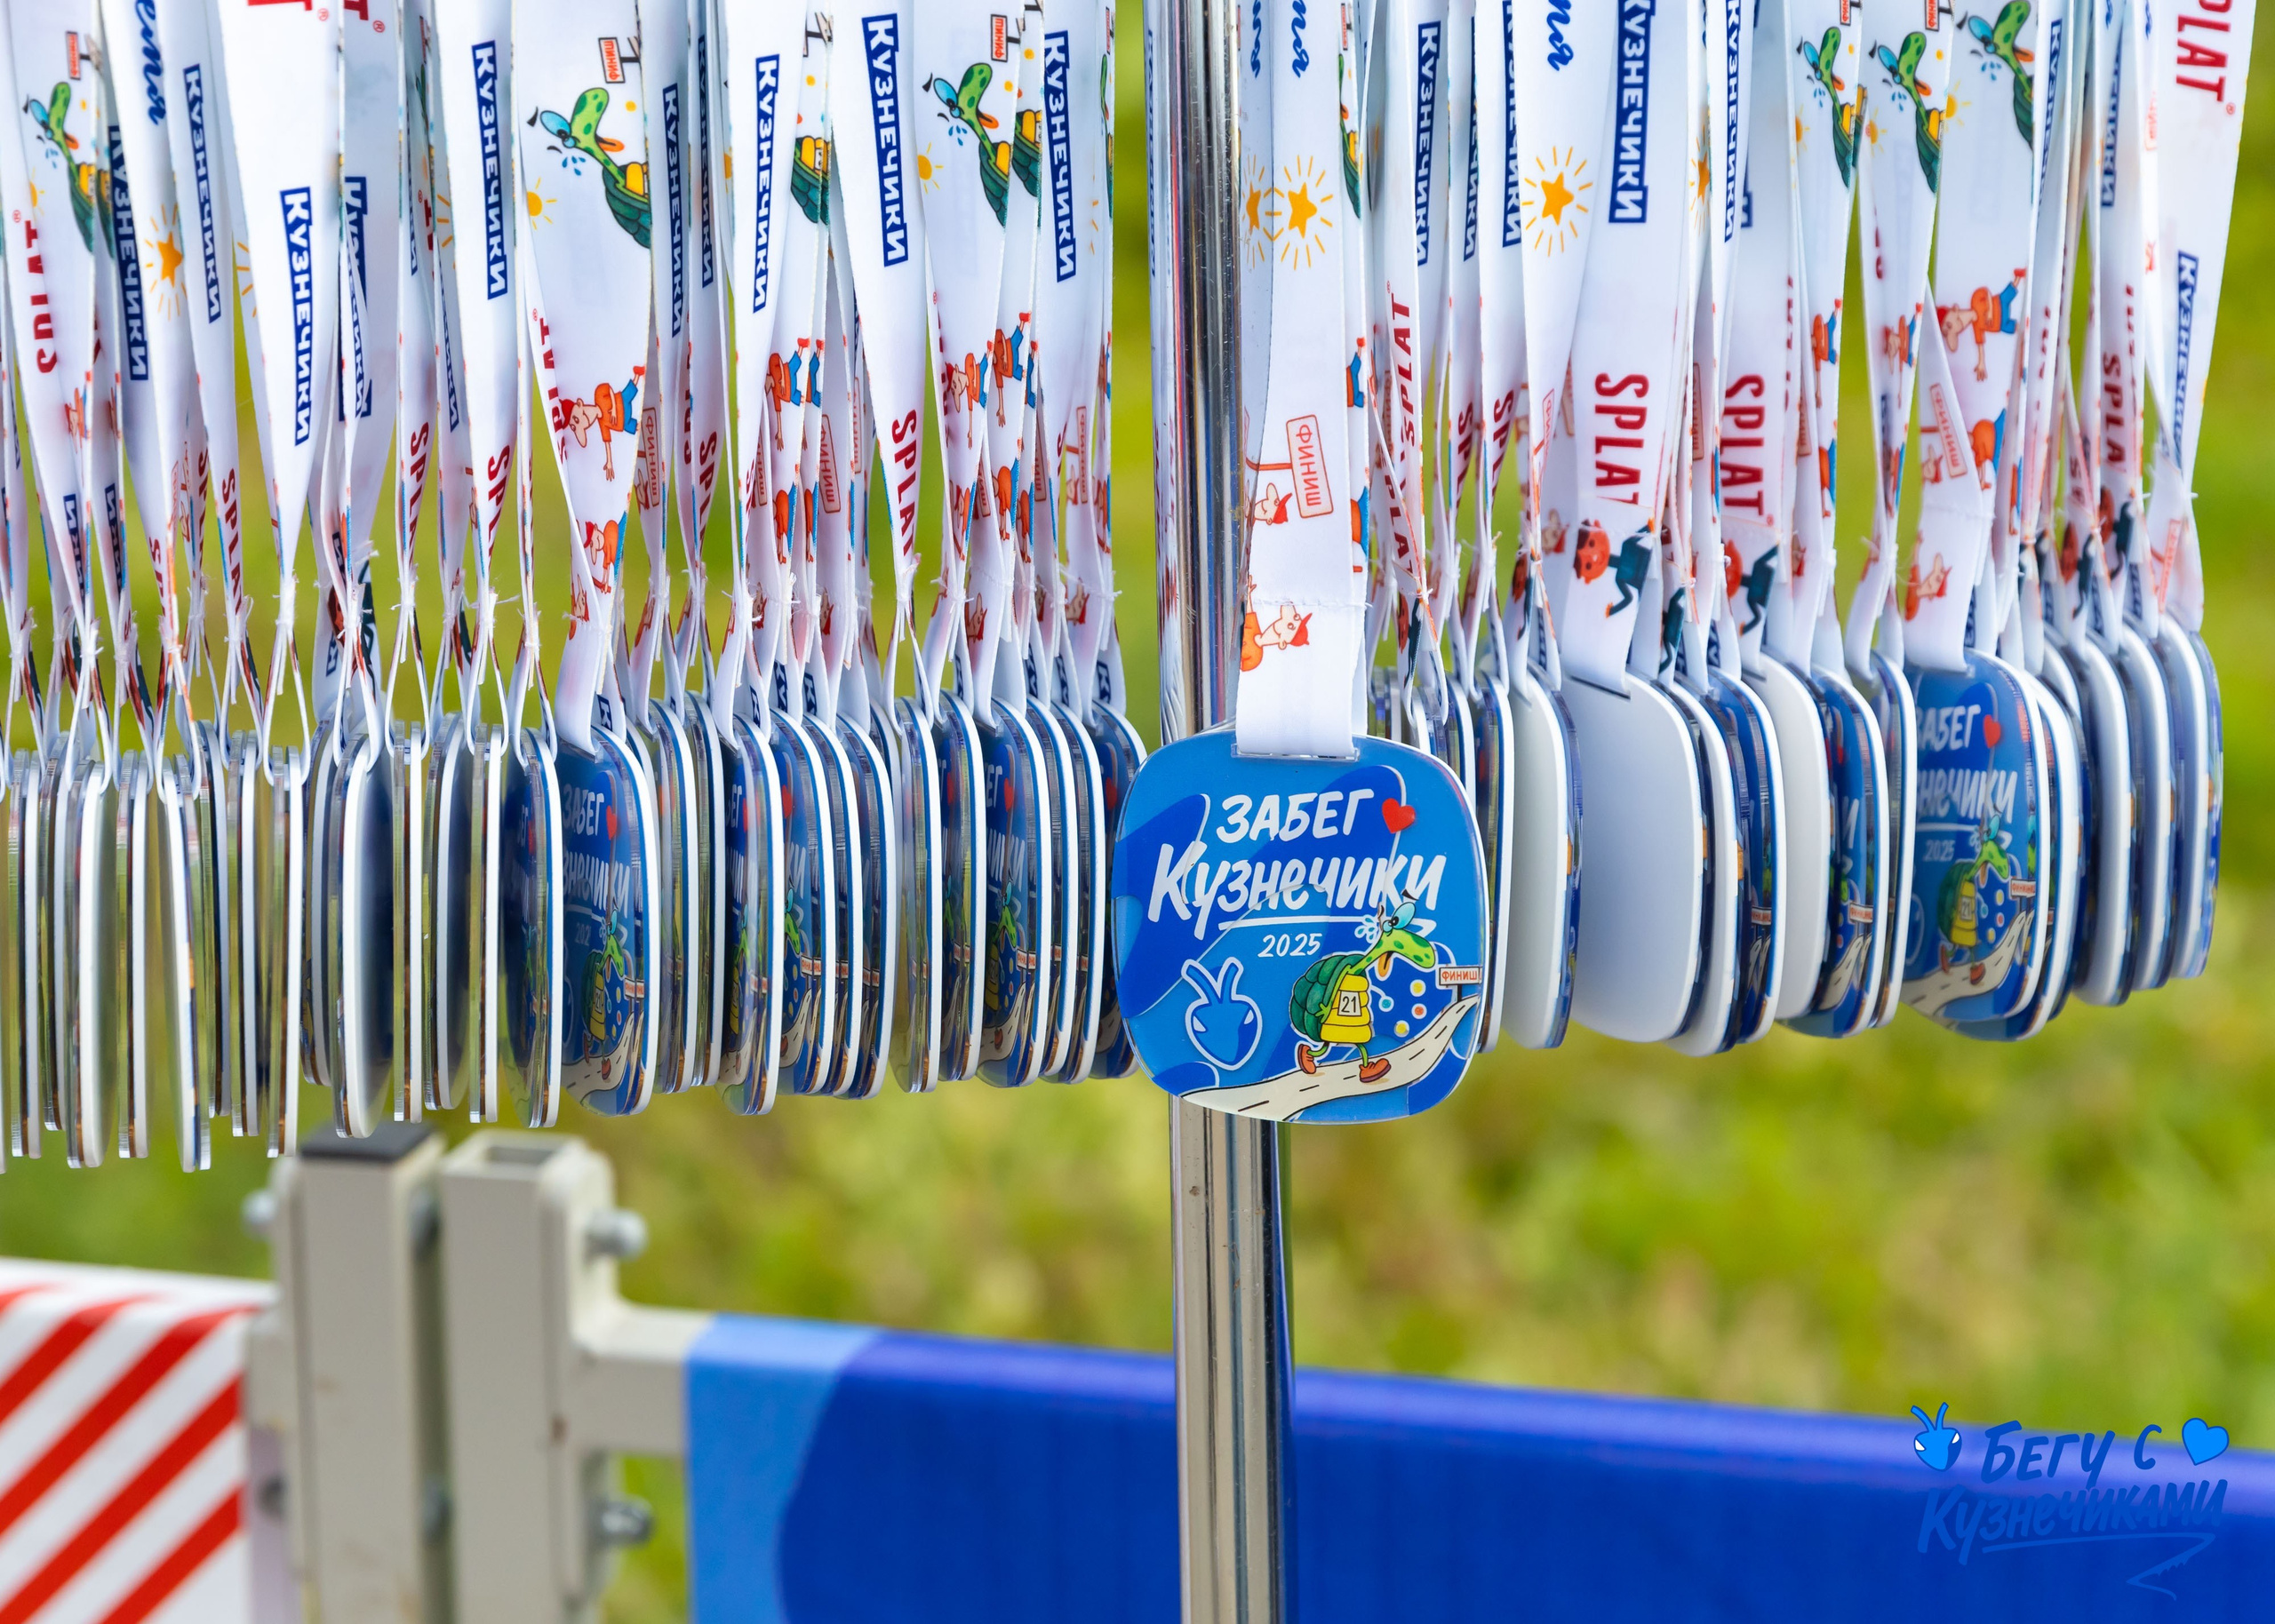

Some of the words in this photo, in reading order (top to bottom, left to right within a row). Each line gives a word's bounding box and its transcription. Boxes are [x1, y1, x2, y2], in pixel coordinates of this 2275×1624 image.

[603, 40, 620, 80] ФИНИШ
[994, 18, 1004, 58] ФИНИШ
[2176, 0, 2233, 102] LAT
[186, 71, 218, 317] КУЗНЕЧИКИ
[475, 46, 506, 296] КУЗНЕЧИКИ
[699, 44, 713, 280] КУЗНЕЧИКИ
[754, 60, 778, 307] КУЗНЕЧИКИ
[868, 18, 906, 260] КУЗНЕЧИКИ
[1045, 36, 1074, 276] КУЗНЕЧИКИ
[1417, 28, 1438, 264] КУЗНЕЧИКИ
[665, 92, 683, 331] КУЗНЕЧИКИ
[284, 193, 311, 441] КУЗНЕЧИКИ
[1392, 293, 1417, 447] SPLAT
[646, 415, 658, 496] ФИНИШ
[1296, 425, 1321, 506] ФИНИШ
[1720, 374, 1765, 516] SPLAT
[2103, 352, 2127, 473] SPLA
[1217, 789, 1375, 844] ЗАБЕГ
[1148, 840, 1448, 941] Кузнечики
[1257, 933, 1323, 959] 2025
[1343, 995, 1357, 1014] 21
[1441, 969, 1479, 982] ФИНИШ
